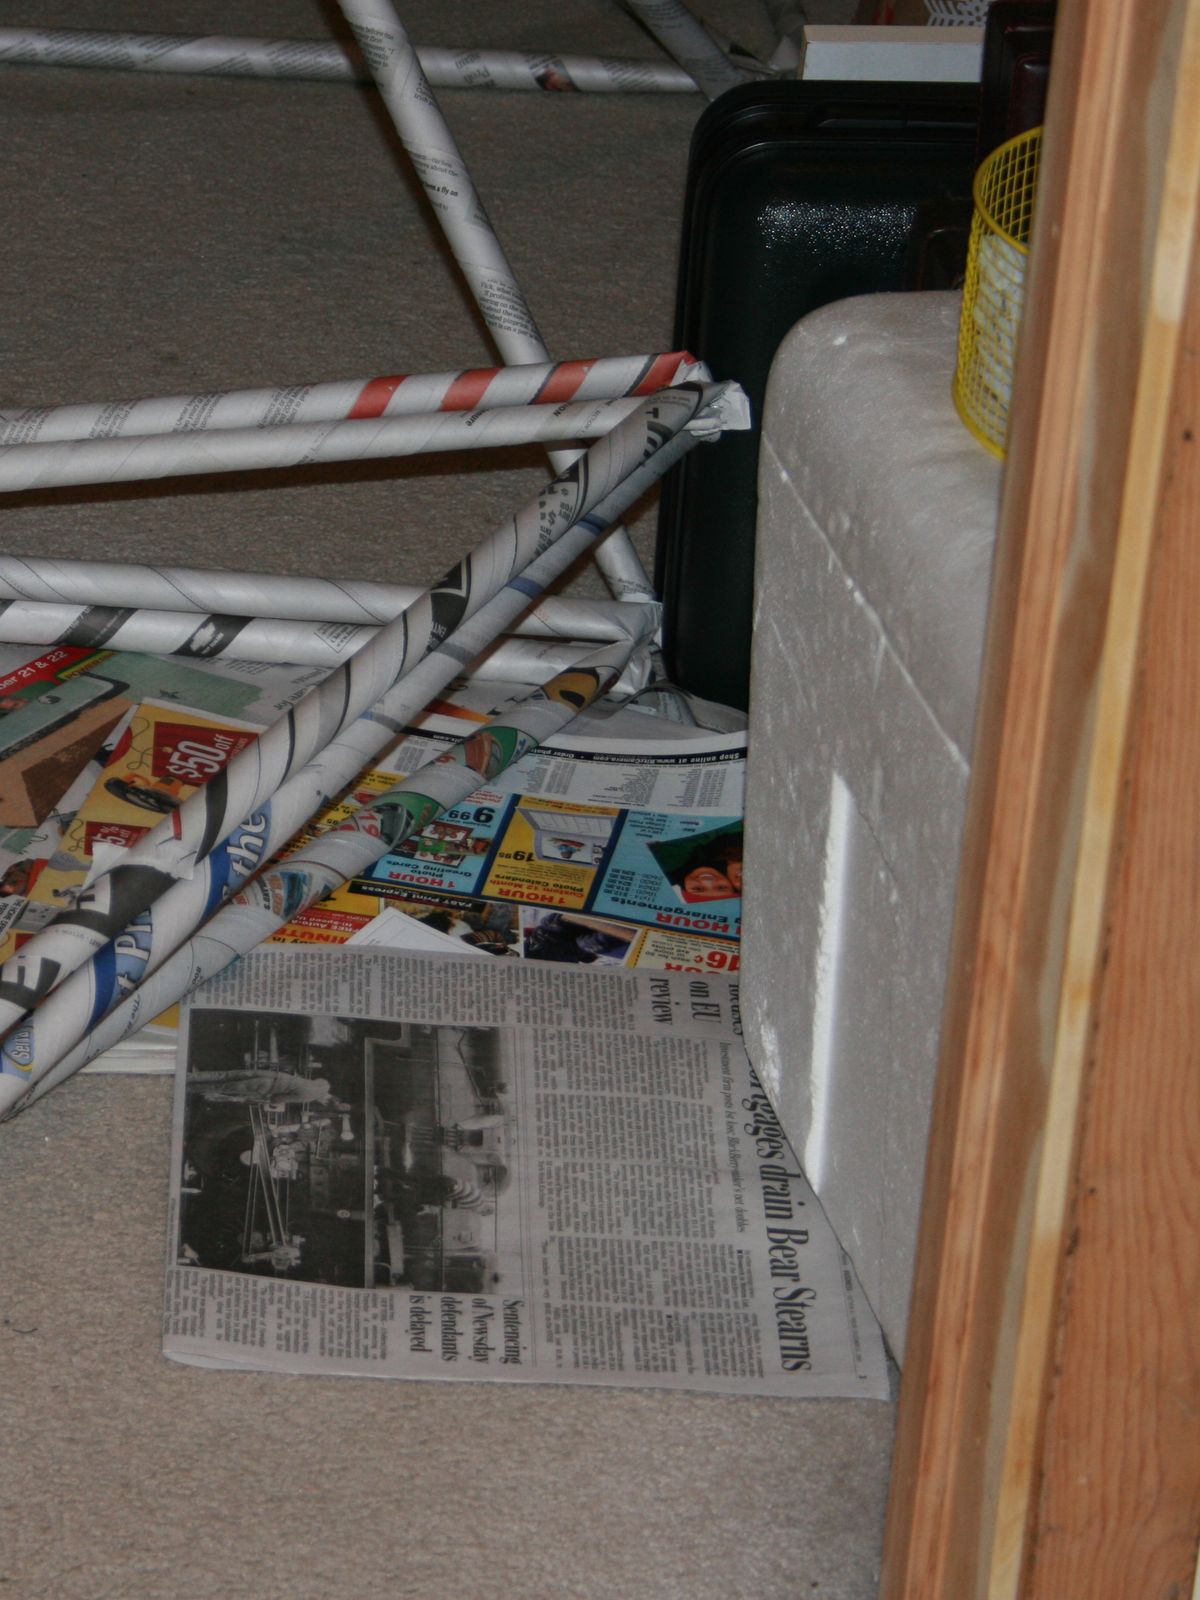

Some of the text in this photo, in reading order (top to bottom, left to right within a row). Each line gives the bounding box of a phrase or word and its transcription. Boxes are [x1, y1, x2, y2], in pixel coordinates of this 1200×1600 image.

[17, 666, 36, 679] 21
[35, 660, 48, 670] &
[48, 650, 69, 664] 22
[167, 732, 235, 779] $50 off
[719, 751, 741, 761] Shop
[226, 811, 268, 877] the
[385, 860, 473, 879] Greeting Cards
[388, 870, 445, 888] HOUR
[410, 868, 444, 879] Photo
[493, 873, 585, 893] Photo Calendars
[360, 884, 473, 909] FAST Print Express
[489, 879, 517, 889] Month
[498, 887, 541, 904] HOUR
[536, 885, 585, 898] Custom
[611, 896, 732, 922] Enlargements
[655, 911, 730, 934] HOUR
[649, 977, 681, 1026] review
[689, 980, 722, 1025] on EU
[719, 1041, 733, 1075] Investment
[722, 1075, 734, 1091] firm
[759, 1163, 806, 1221] drain
[735, 1206, 748, 1233] doubles
[766, 1227, 810, 1284] Bear
[409, 1309, 434, 1354] delayed
[440, 1296, 459, 1363] defendants
[472, 1310, 496, 1365] Newsday
[501, 1298, 528, 1367] Sentencing
[774, 1286, 818, 1374] Stearns
